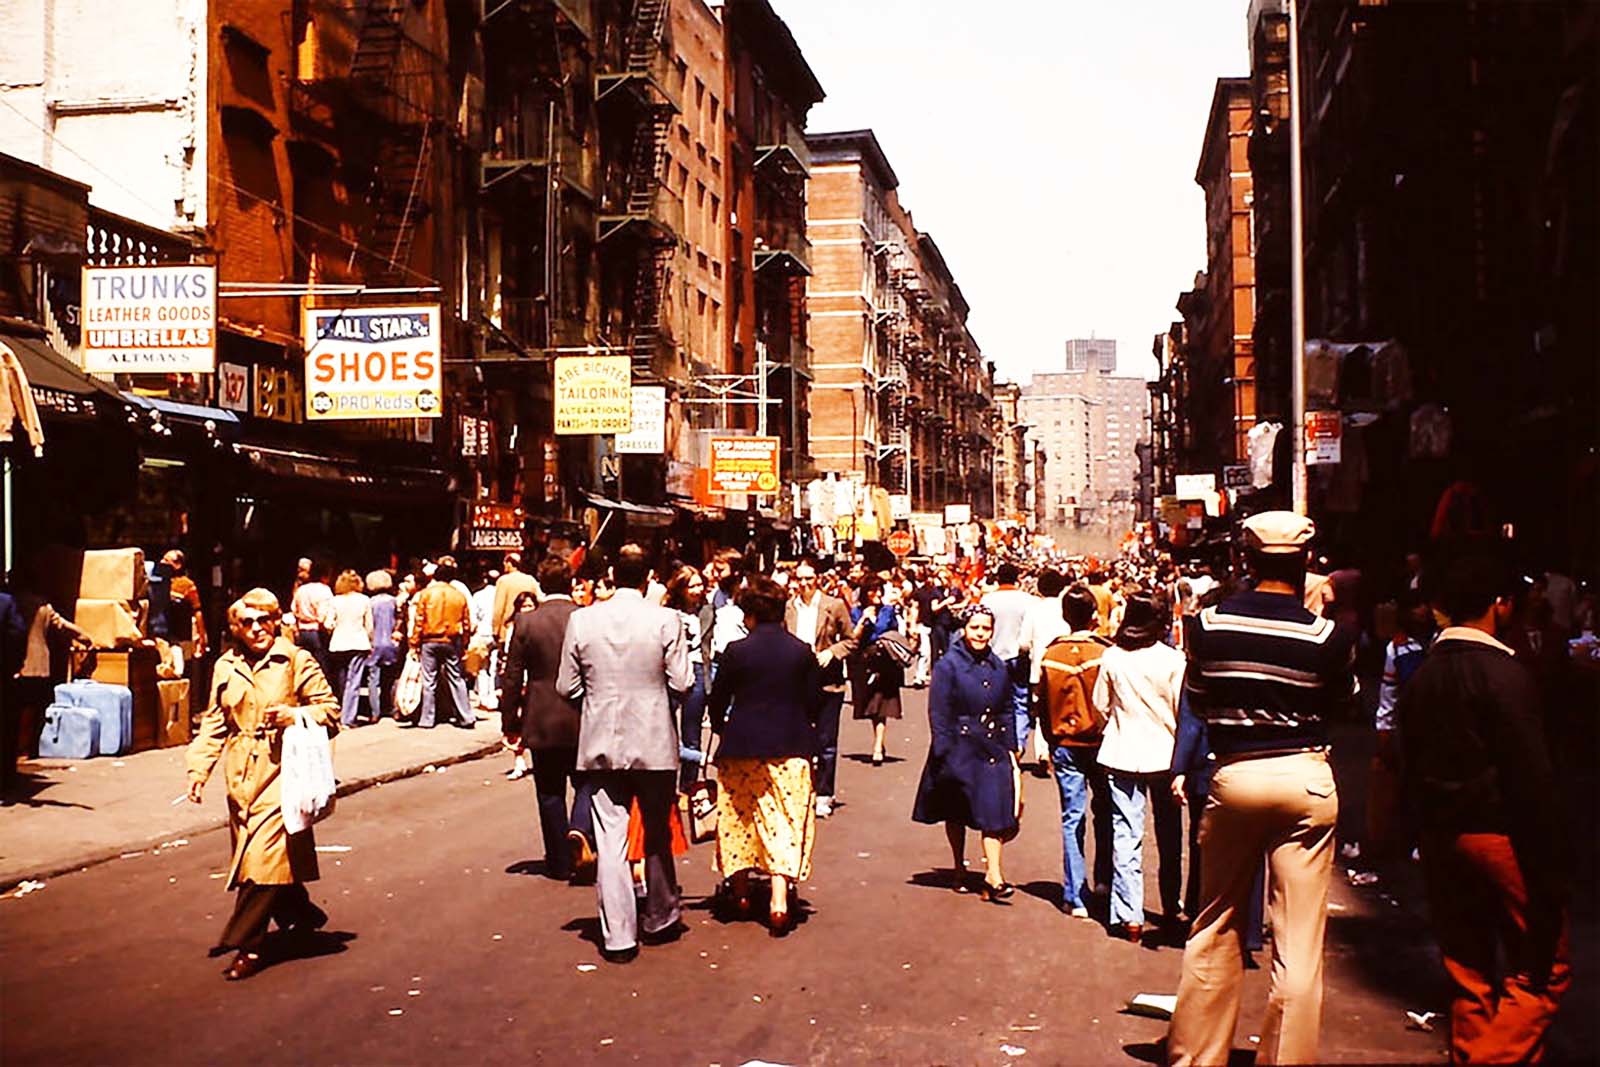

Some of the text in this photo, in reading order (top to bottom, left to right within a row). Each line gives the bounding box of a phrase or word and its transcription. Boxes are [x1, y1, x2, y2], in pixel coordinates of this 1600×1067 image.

[91, 273, 207, 300] TRUNKS
[89, 305, 211, 323] LEATHER GOODS
[334, 317, 412, 340] ALL STAR
[88, 328, 211, 348] UMBRELLAS
[314, 350, 435, 383] SHOES
[557, 365, 583, 386] ABE
[225, 371, 245, 404] 137
[559, 386, 629, 400] TAILORING
[374, 393, 414, 411] Keds
[558, 406, 627, 415] ALTERATIONS
[589, 418, 600, 429] TO
[600, 418, 629, 430] ORDER
[617, 440, 659, 450] DRESSES
[712, 440, 734, 451] TOP
